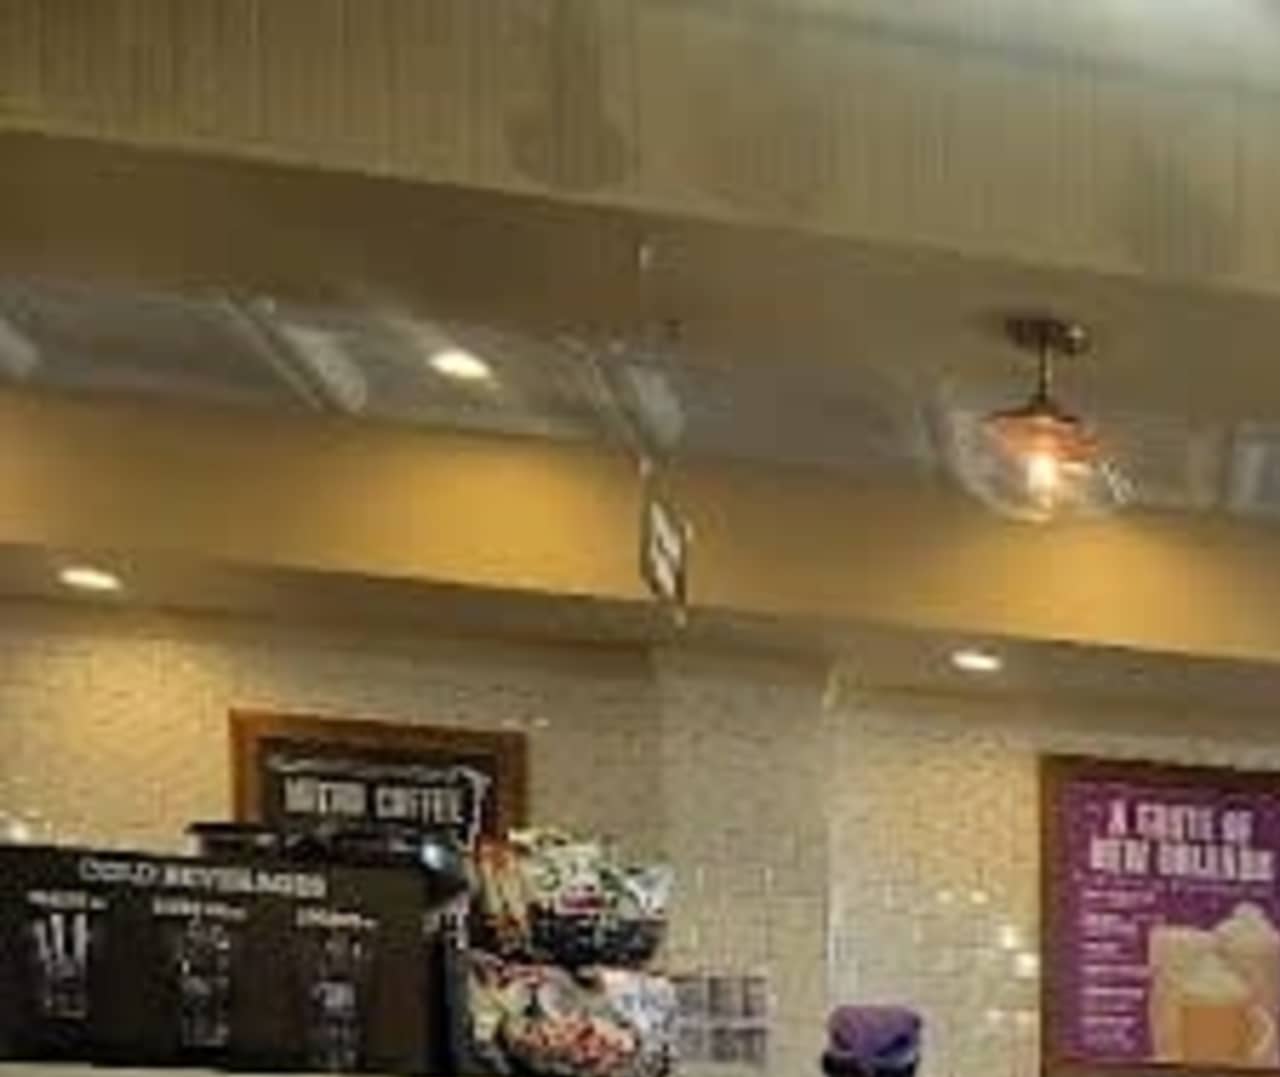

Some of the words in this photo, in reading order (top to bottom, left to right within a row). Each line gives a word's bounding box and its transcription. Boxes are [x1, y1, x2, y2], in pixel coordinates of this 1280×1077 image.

[1107, 800, 1127, 835] A
[1222, 809, 1253, 841] OF
[79, 856, 158, 885] COLD
[163, 863, 327, 898] BEVERAGES
[1090, 836, 1149, 875] NEW
[1159, 843, 1275, 881] ORLEANS
